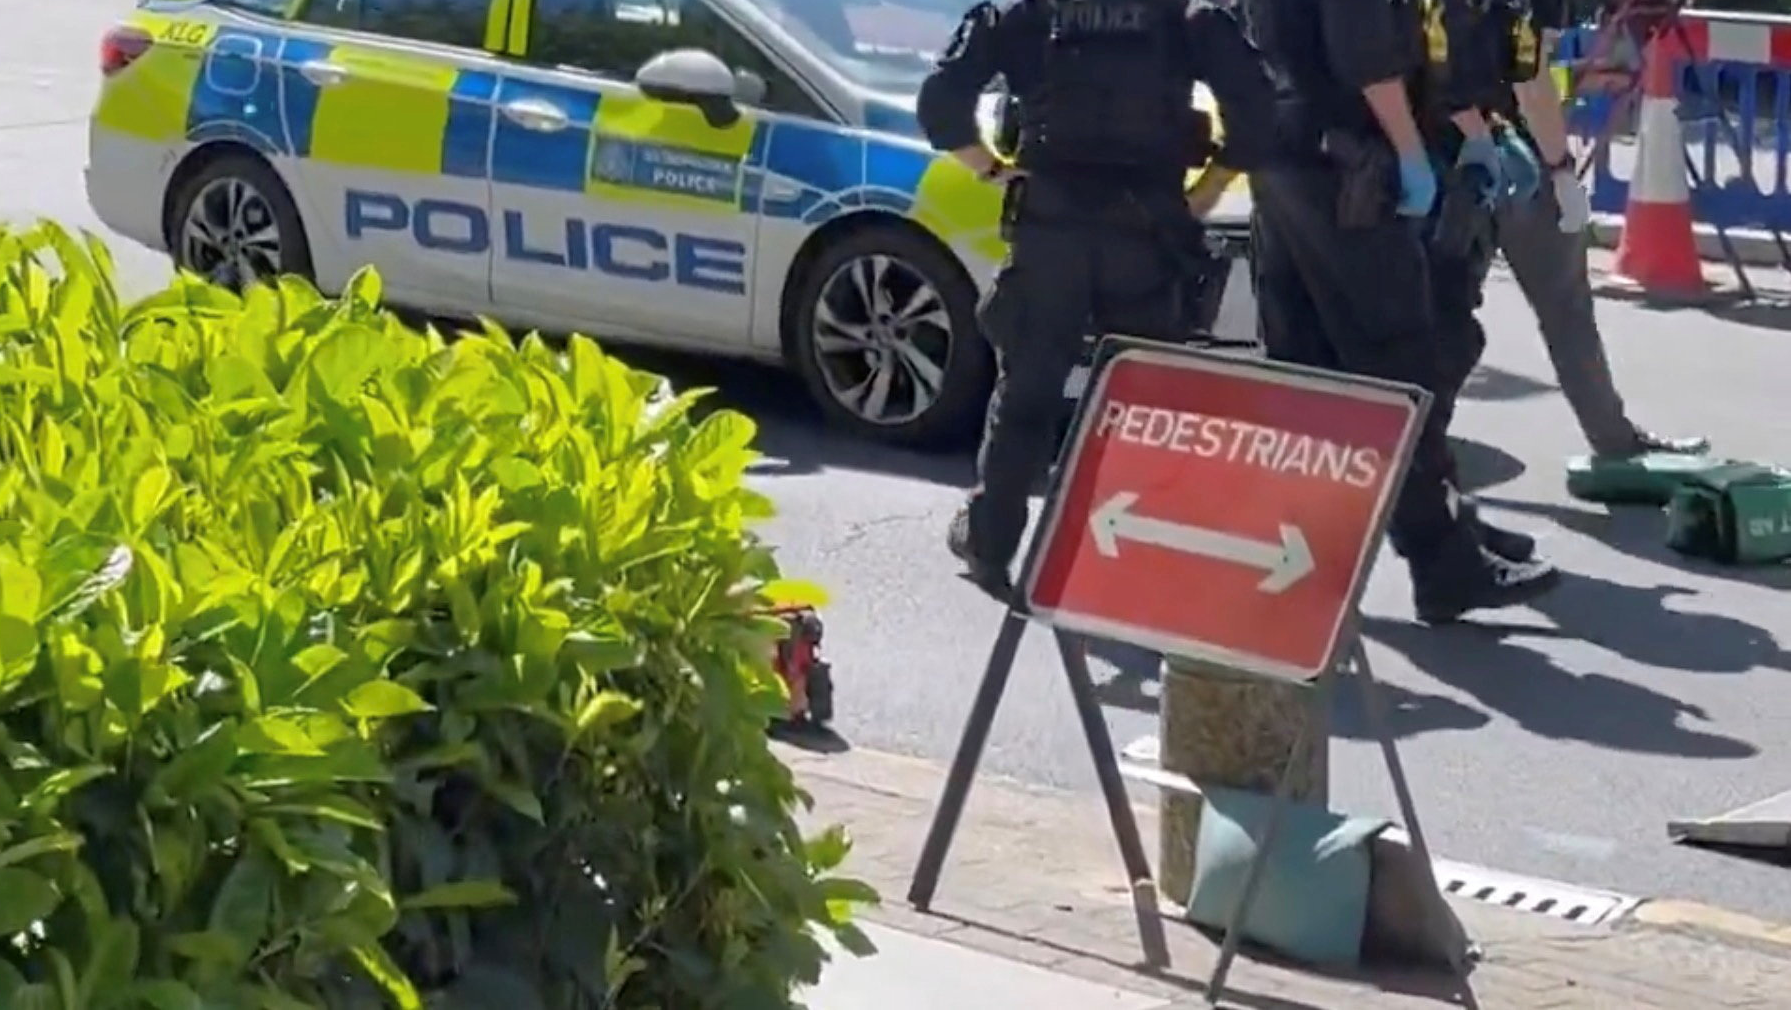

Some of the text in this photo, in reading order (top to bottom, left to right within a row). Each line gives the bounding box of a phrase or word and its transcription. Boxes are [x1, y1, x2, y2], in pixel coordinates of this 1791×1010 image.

[653, 167, 717, 193] POLICE
[345, 188, 746, 295] POLICE
[1097, 399, 1381, 488] PEDESTRIANS
